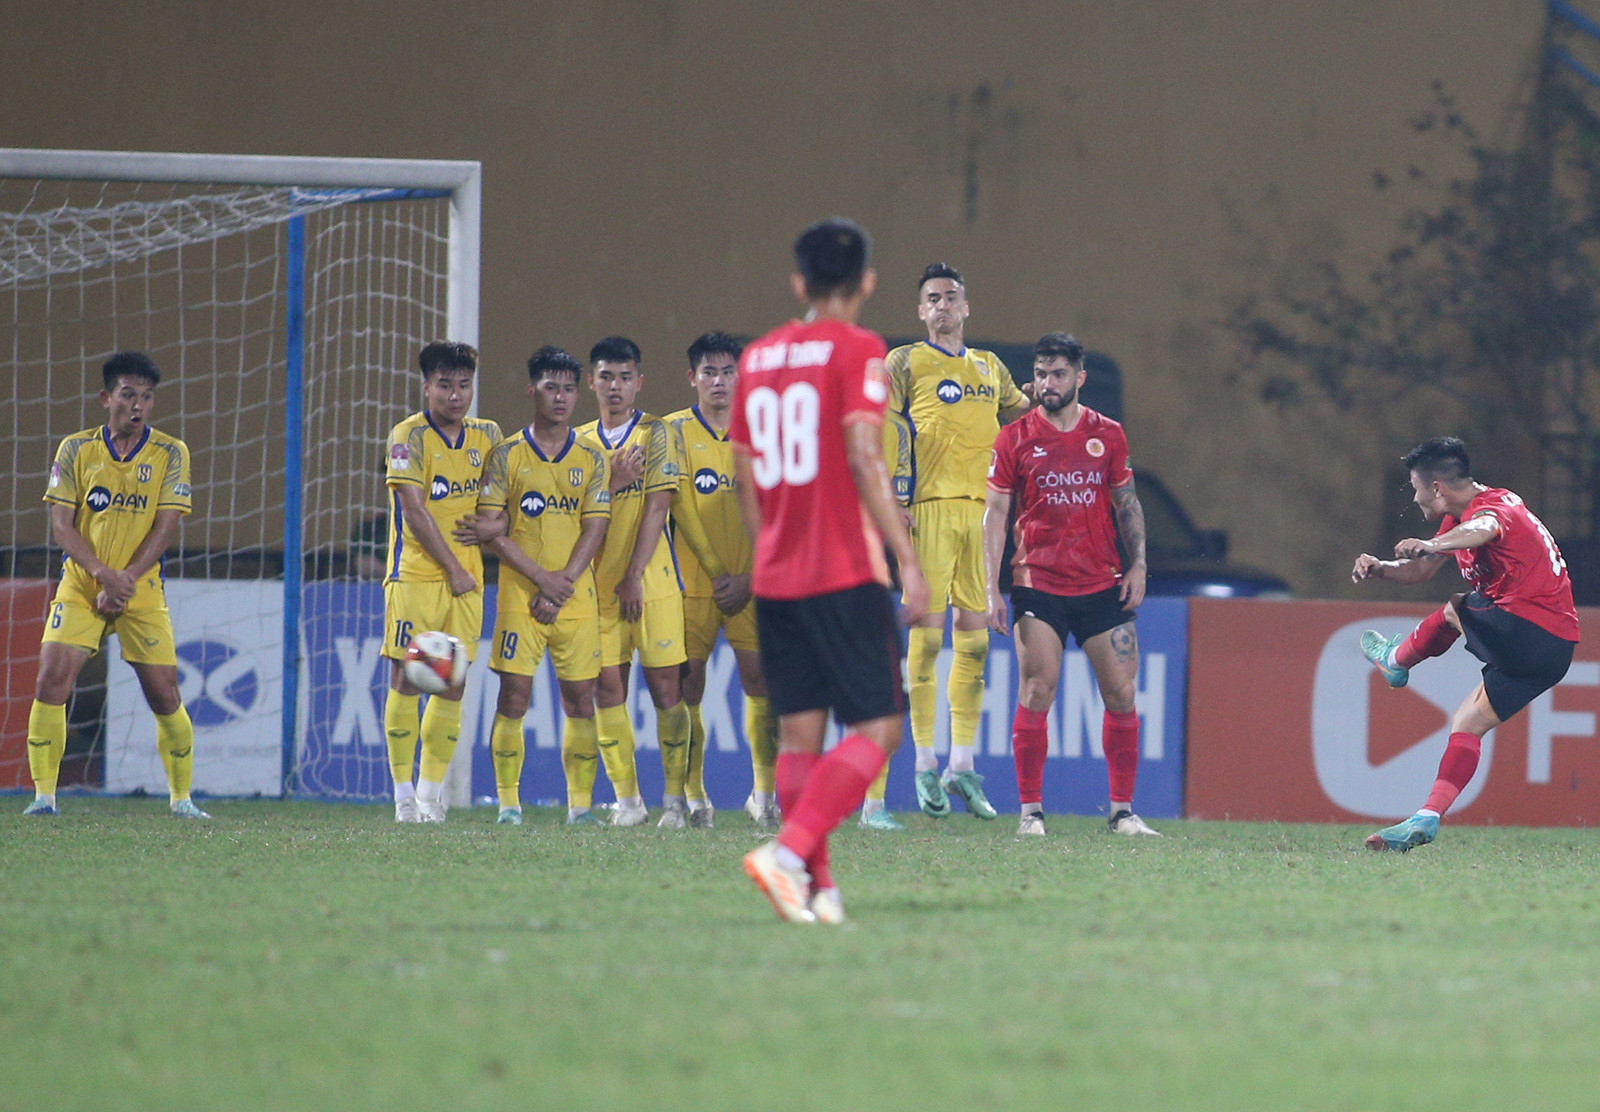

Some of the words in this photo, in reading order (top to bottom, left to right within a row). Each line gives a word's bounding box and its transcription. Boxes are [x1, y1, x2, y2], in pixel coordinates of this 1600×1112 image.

[964, 383, 995, 399] AAN
[745, 381, 820, 490] 98
[1036, 470, 1083, 489] CÔNG
[112, 492, 148, 509] AAN
[547, 495, 579, 511] AAN
[1046, 489, 1071, 505] HÀ
[52, 602, 63, 629] 6
[395, 619, 413, 649] 16
[500, 629, 519, 661] 19
